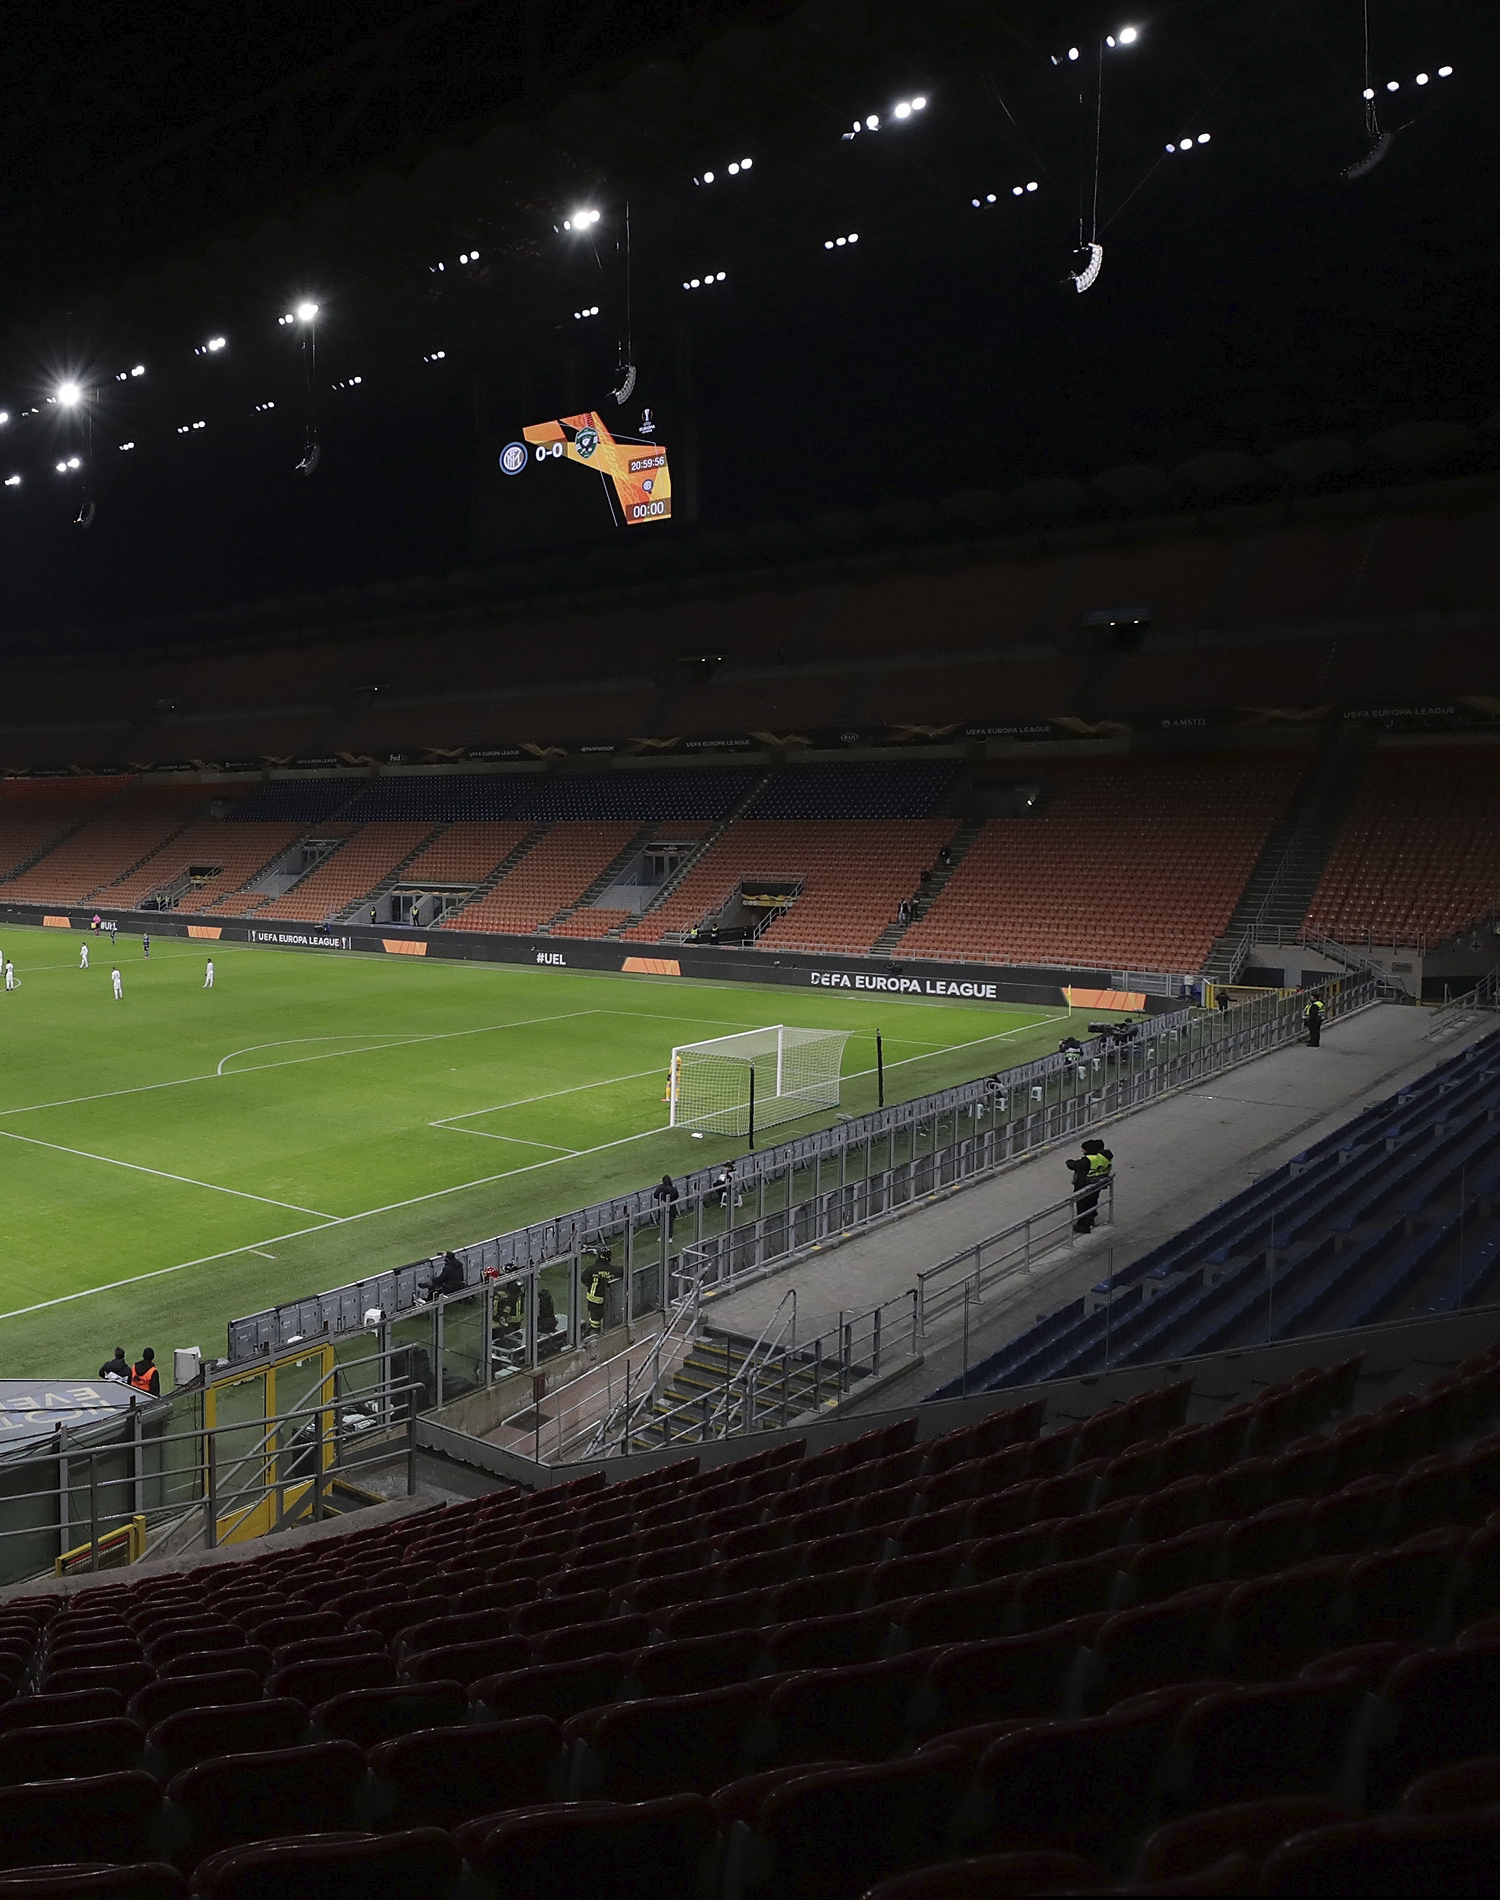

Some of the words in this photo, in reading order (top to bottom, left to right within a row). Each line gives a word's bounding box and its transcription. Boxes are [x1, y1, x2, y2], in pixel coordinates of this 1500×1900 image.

[535, 442, 564, 461] 0-0
[630, 456, 664, 472] 20:59:56
[633, 502, 664, 518] 00:00
[1343, 710, 1370, 718] UEFA
[1372, 708, 1413, 717] EUROPA
[1415, 706, 1456, 715] LEAGUE
[1172, 718, 1208, 726] AMSTEL
[965, 728, 986, 736] UEFA
[258, 932, 277, 941] UEFA
[278, 934, 307, 944] EUROPA
[309, 936, 340, 947] LEAGUE
[536, 952, 566, 966] #UEL
[855, 975, 921, 993] EUROPA
[926, 980, 996, 998] LEAGUE
